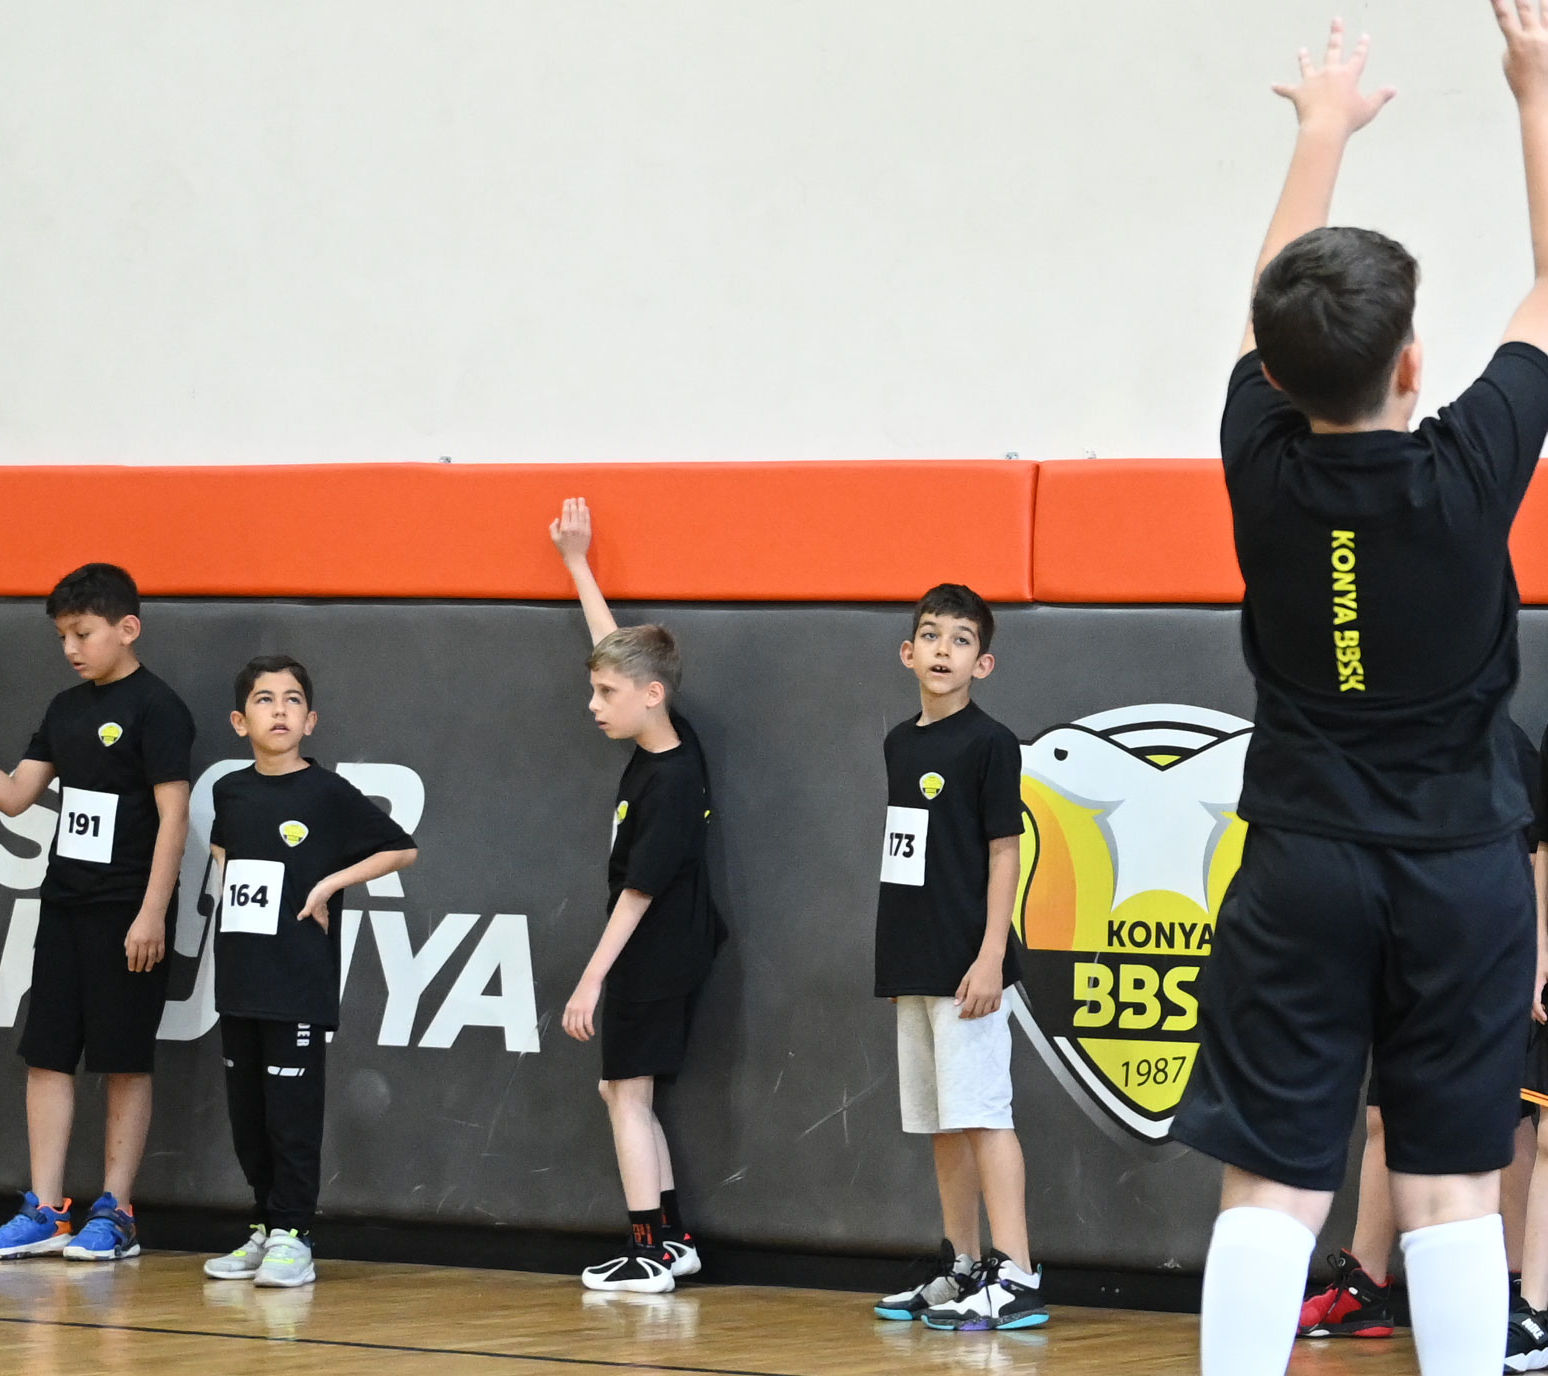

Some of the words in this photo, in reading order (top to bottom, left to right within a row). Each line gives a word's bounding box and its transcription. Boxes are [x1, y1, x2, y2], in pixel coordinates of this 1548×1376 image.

[1331, 530, 1358, 625] KONYA
[1333, 630, 1366, 692] BBSK
[68, 811, 101, 837] 191
[889, 832, 915, 858] 173
[229, 884, 269, 908] 164
[1107, 920, 1215, 950] KONYA
[1073, 962, 1201, 1031] BBS
[1121, 1056, 1187, 1087] 1987
